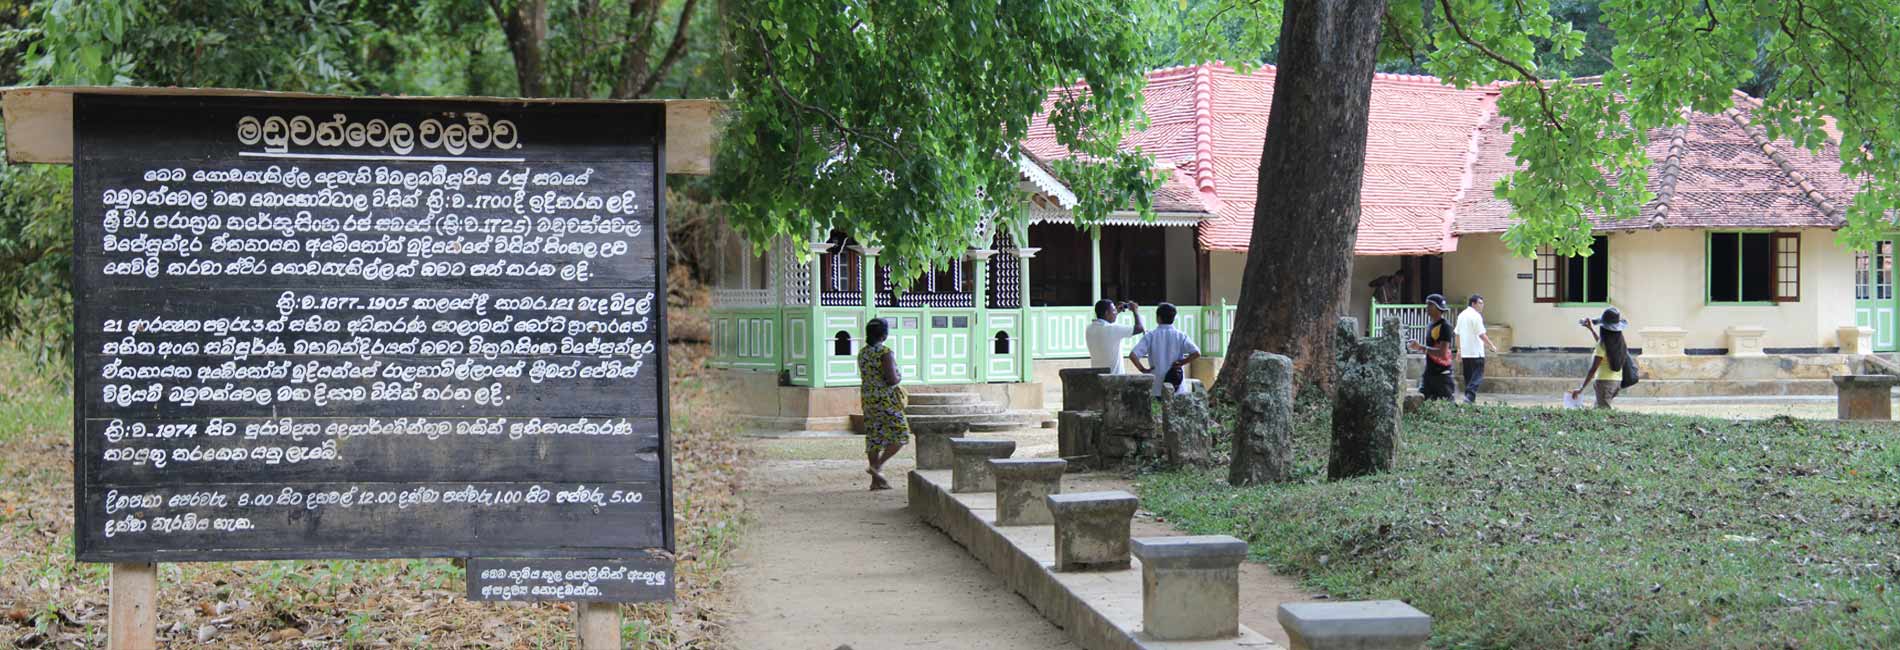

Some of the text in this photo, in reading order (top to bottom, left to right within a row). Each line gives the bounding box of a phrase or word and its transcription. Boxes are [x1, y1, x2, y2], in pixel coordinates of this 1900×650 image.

[144, 168, 186, 182] මෙම
[213, 191, 246, 207] මහ
[373, 188, 422, 208] විසින්
[495, 235, 543, 254] විසින්
[420, 261, 466, 277] බවට
[506, 261, 556, 277] කරන
[103, 319, 122, 332] 21
[420, 340, 465, 355] බවට
[276, 385, 311, 402] මහ
[370, 381, 422, 401] විසින්
[421, 383, 472, 401] කරන
[204, 417, 237, 436] සිට
[275, 486, 304, 506] සිට
[358, 490, 397, 505] 12.00
[523, 484, 551, 504] සිට
[608, 490, 643, 504] 5.00
